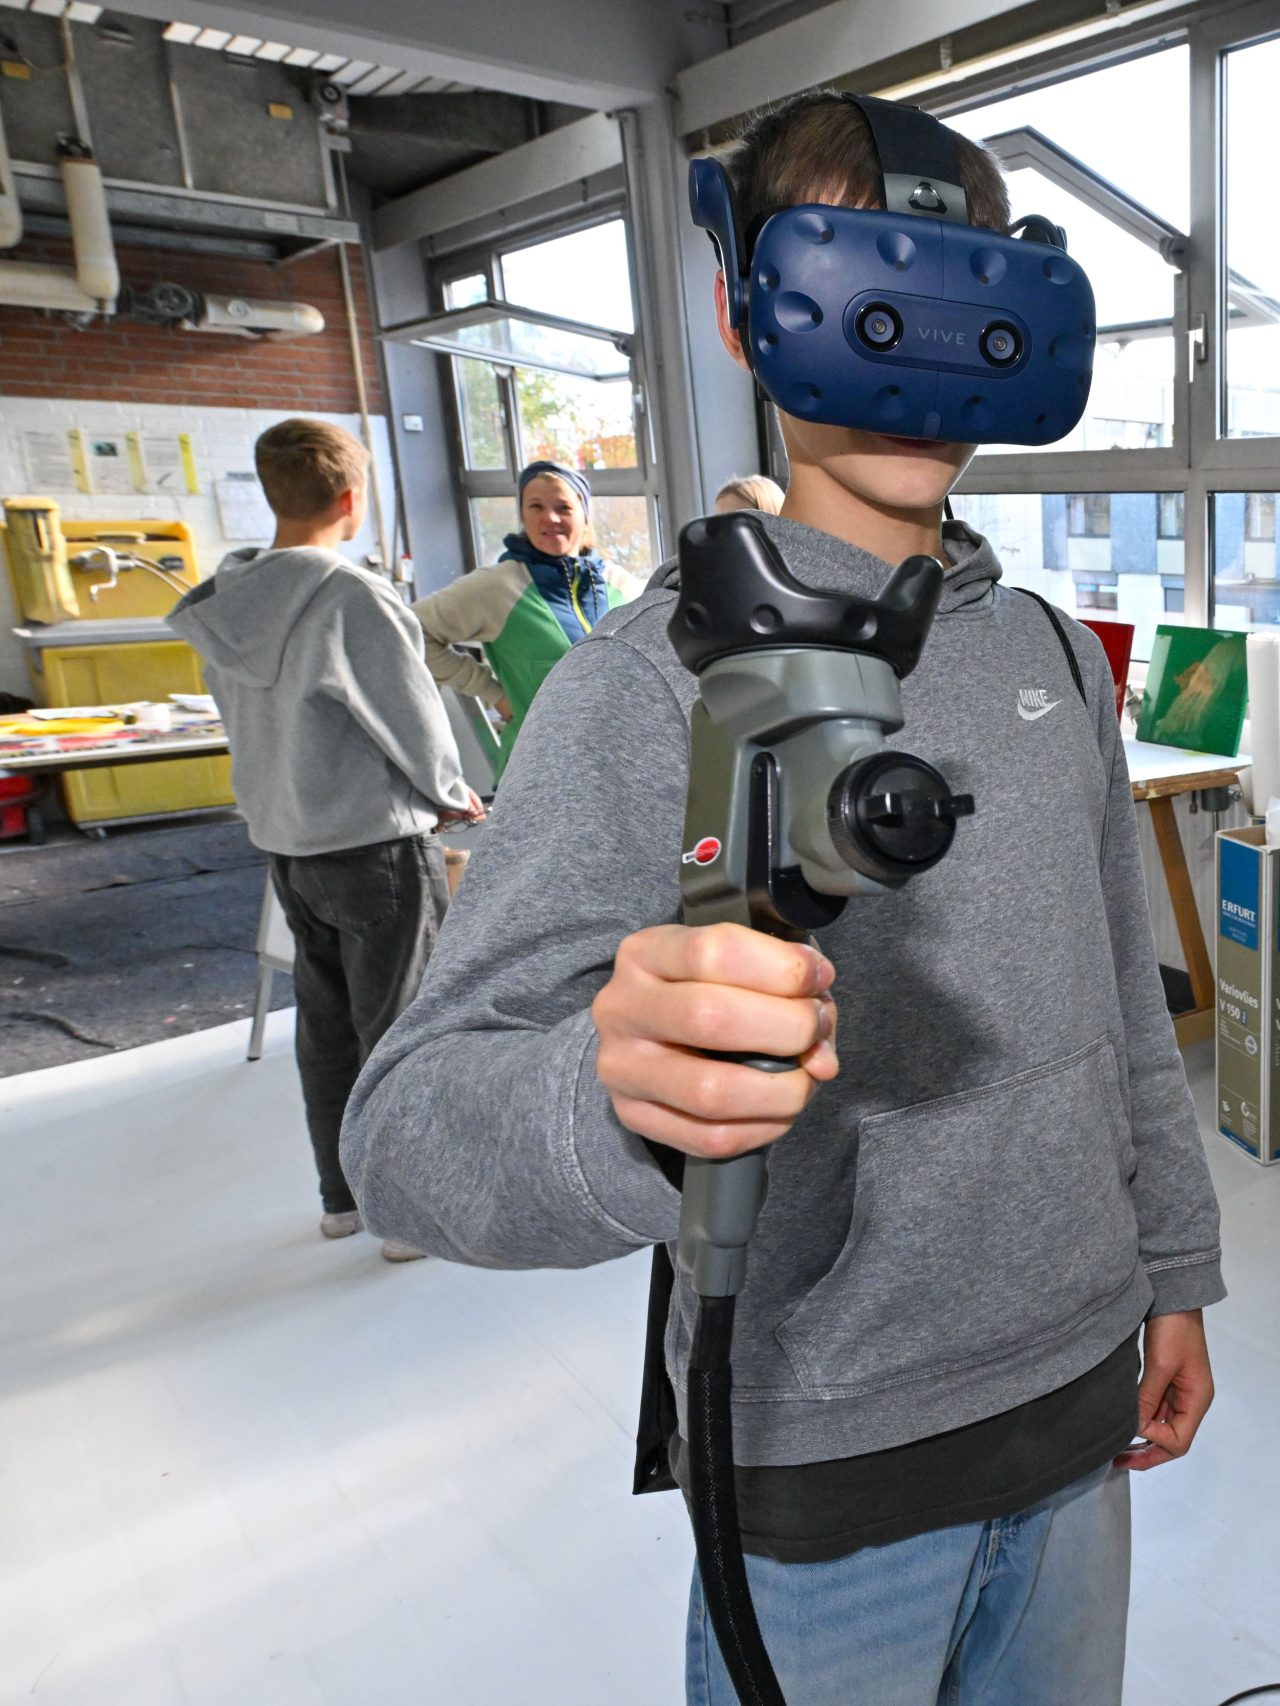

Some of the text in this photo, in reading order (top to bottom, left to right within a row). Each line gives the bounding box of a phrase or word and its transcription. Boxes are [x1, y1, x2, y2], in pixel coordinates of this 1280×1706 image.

[918, 327, 966, 345] VIVE
[1018, 689, 1048, 708] NIKE
[1222, 899, 1256, 922] ERFURT
[1219, 978, 1259, 1009] Variovlies
[1219, 998, 1226, 1011] V
[1226, 1003, 1240, 1020] 150
